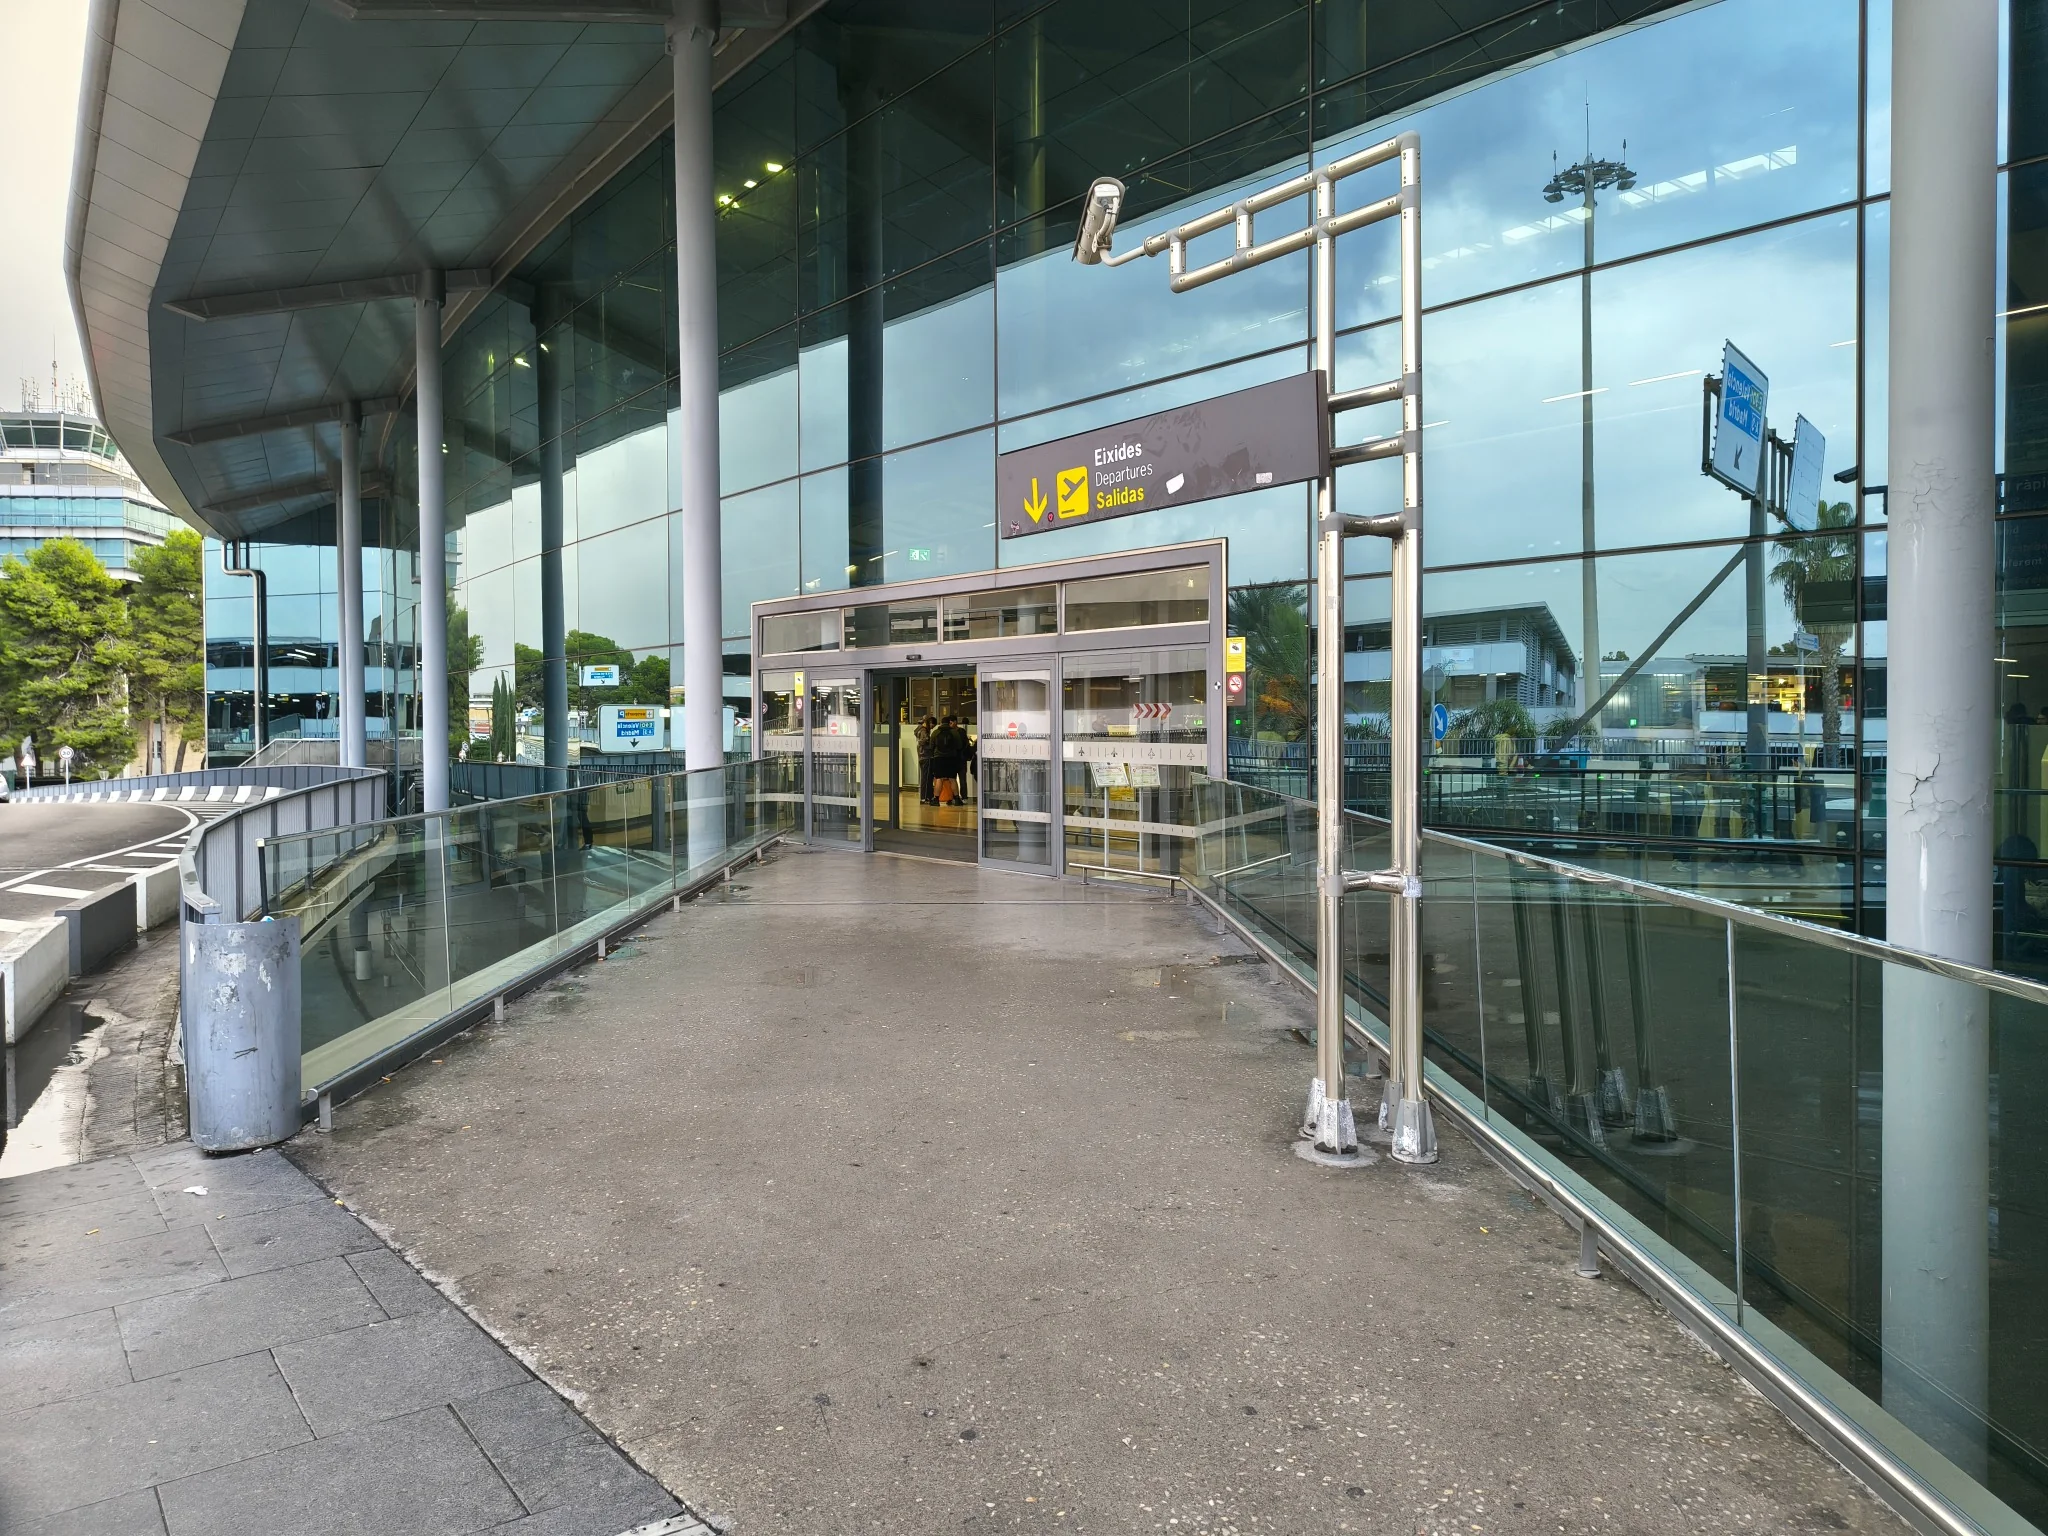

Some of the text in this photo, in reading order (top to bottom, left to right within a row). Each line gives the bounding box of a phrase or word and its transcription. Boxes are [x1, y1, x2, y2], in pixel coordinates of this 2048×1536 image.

[1094, 442, 1142, 466] Eixides
[1095, 463, 1153, 487] Departures
[2016, 477, 2048, 491] ràpi
[1096, 486, 1144, 509] Salidas
